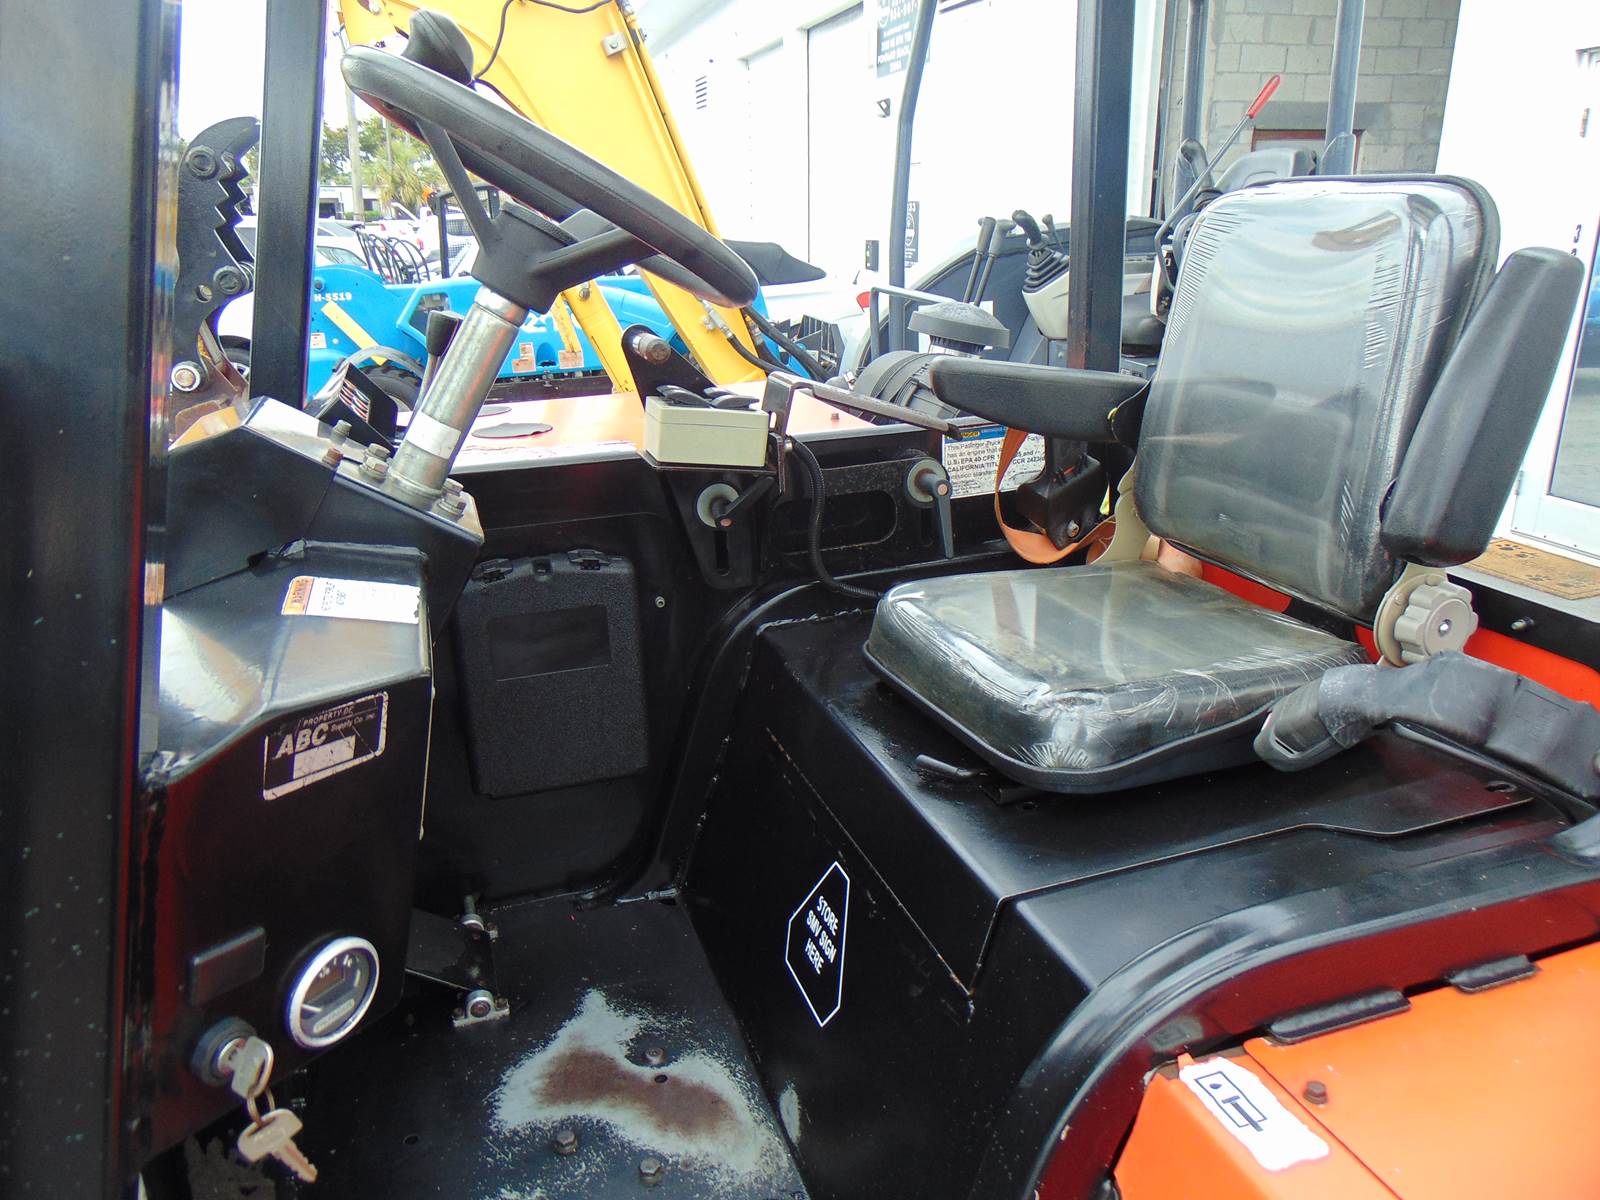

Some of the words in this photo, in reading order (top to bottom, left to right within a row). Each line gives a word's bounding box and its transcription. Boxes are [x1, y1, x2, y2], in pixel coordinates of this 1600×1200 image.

[947, 462, 985, 473] CALIFORNIA
[303, 711, 341, 727] PROPERTY
[331, 719, 353, 731] Supply
[272, 722, 328, 759] ABC
[817, 896, 838, 936] STORE
[807, 910, 822, 937] SMV
[818, 930, 837, 964] SIGN
[805, 938, 824, 974] HERE
